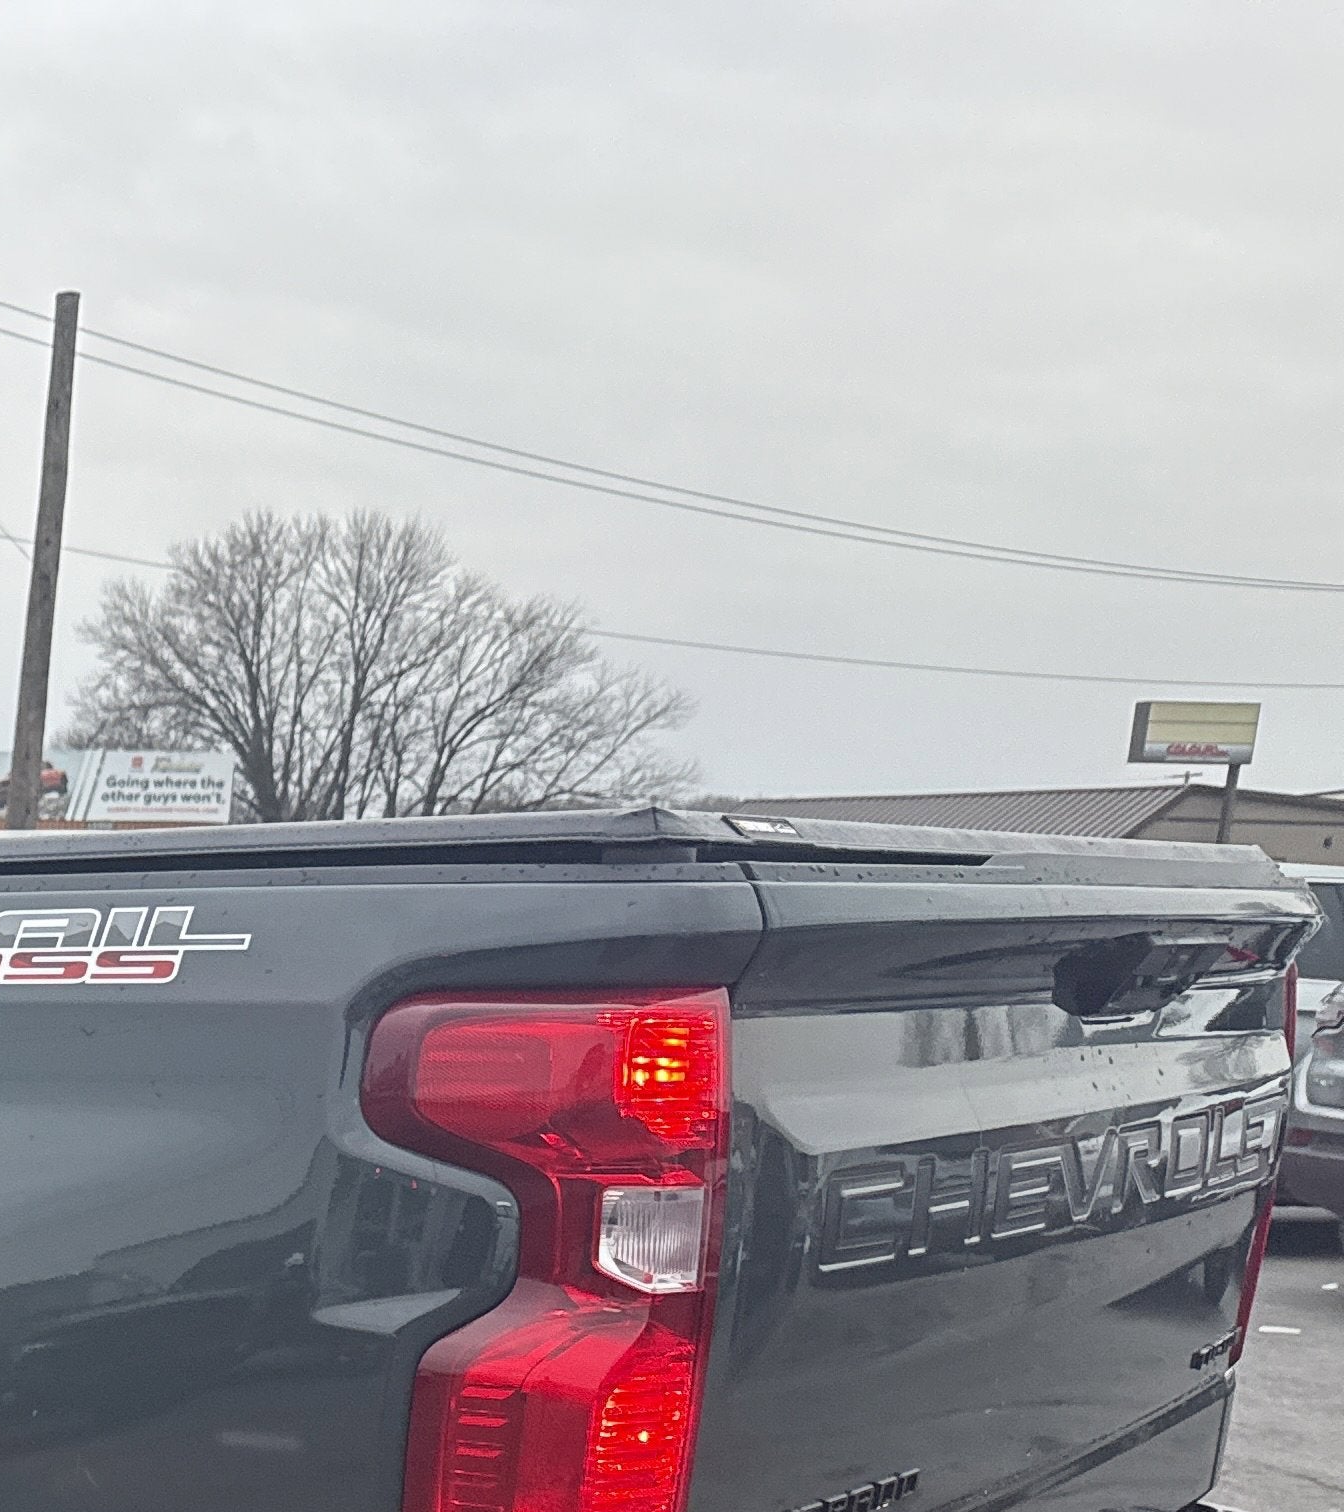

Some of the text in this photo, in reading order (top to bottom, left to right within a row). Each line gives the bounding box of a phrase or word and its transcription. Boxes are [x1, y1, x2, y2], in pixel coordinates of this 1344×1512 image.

[106, 775, 225, 790] Going where the
[101, 790, 141, 802] other
[143, 791, 177, 805] guys
